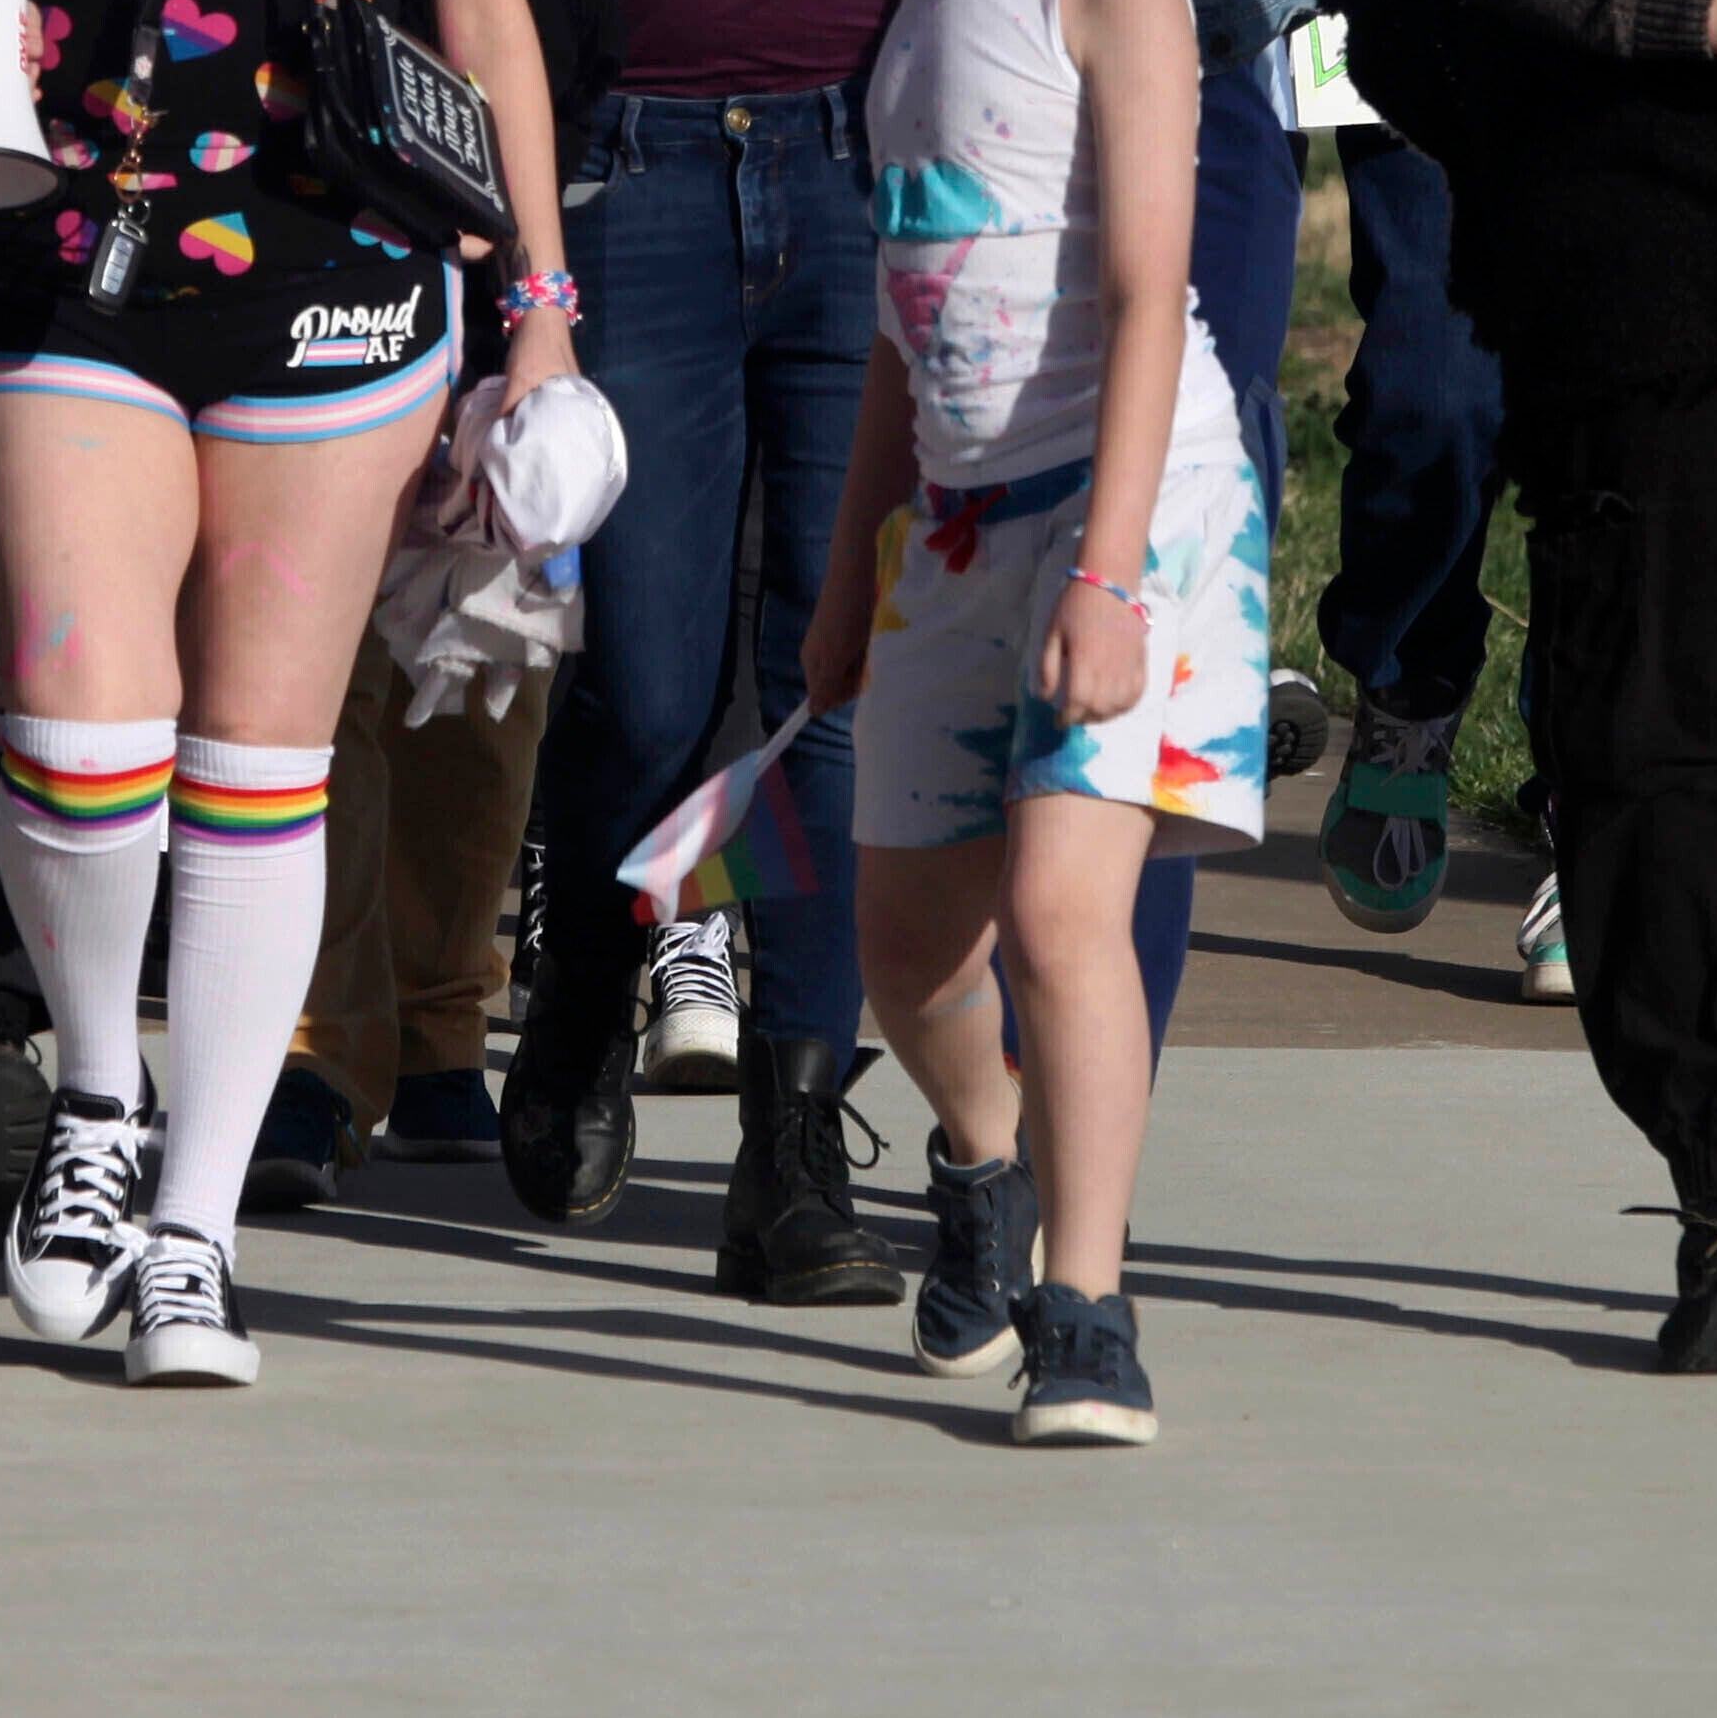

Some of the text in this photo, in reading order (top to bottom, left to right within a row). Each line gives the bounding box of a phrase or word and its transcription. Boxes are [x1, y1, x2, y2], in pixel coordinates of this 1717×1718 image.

[397, 56, 423, 129] Little
[417, 70, 443, 146] Black
[438, 83, 465, 164] Magic
[457, 103, 482, 172] Book
[286, 284, 421, 368] Proud
[365, 334, 406, 364] AF
